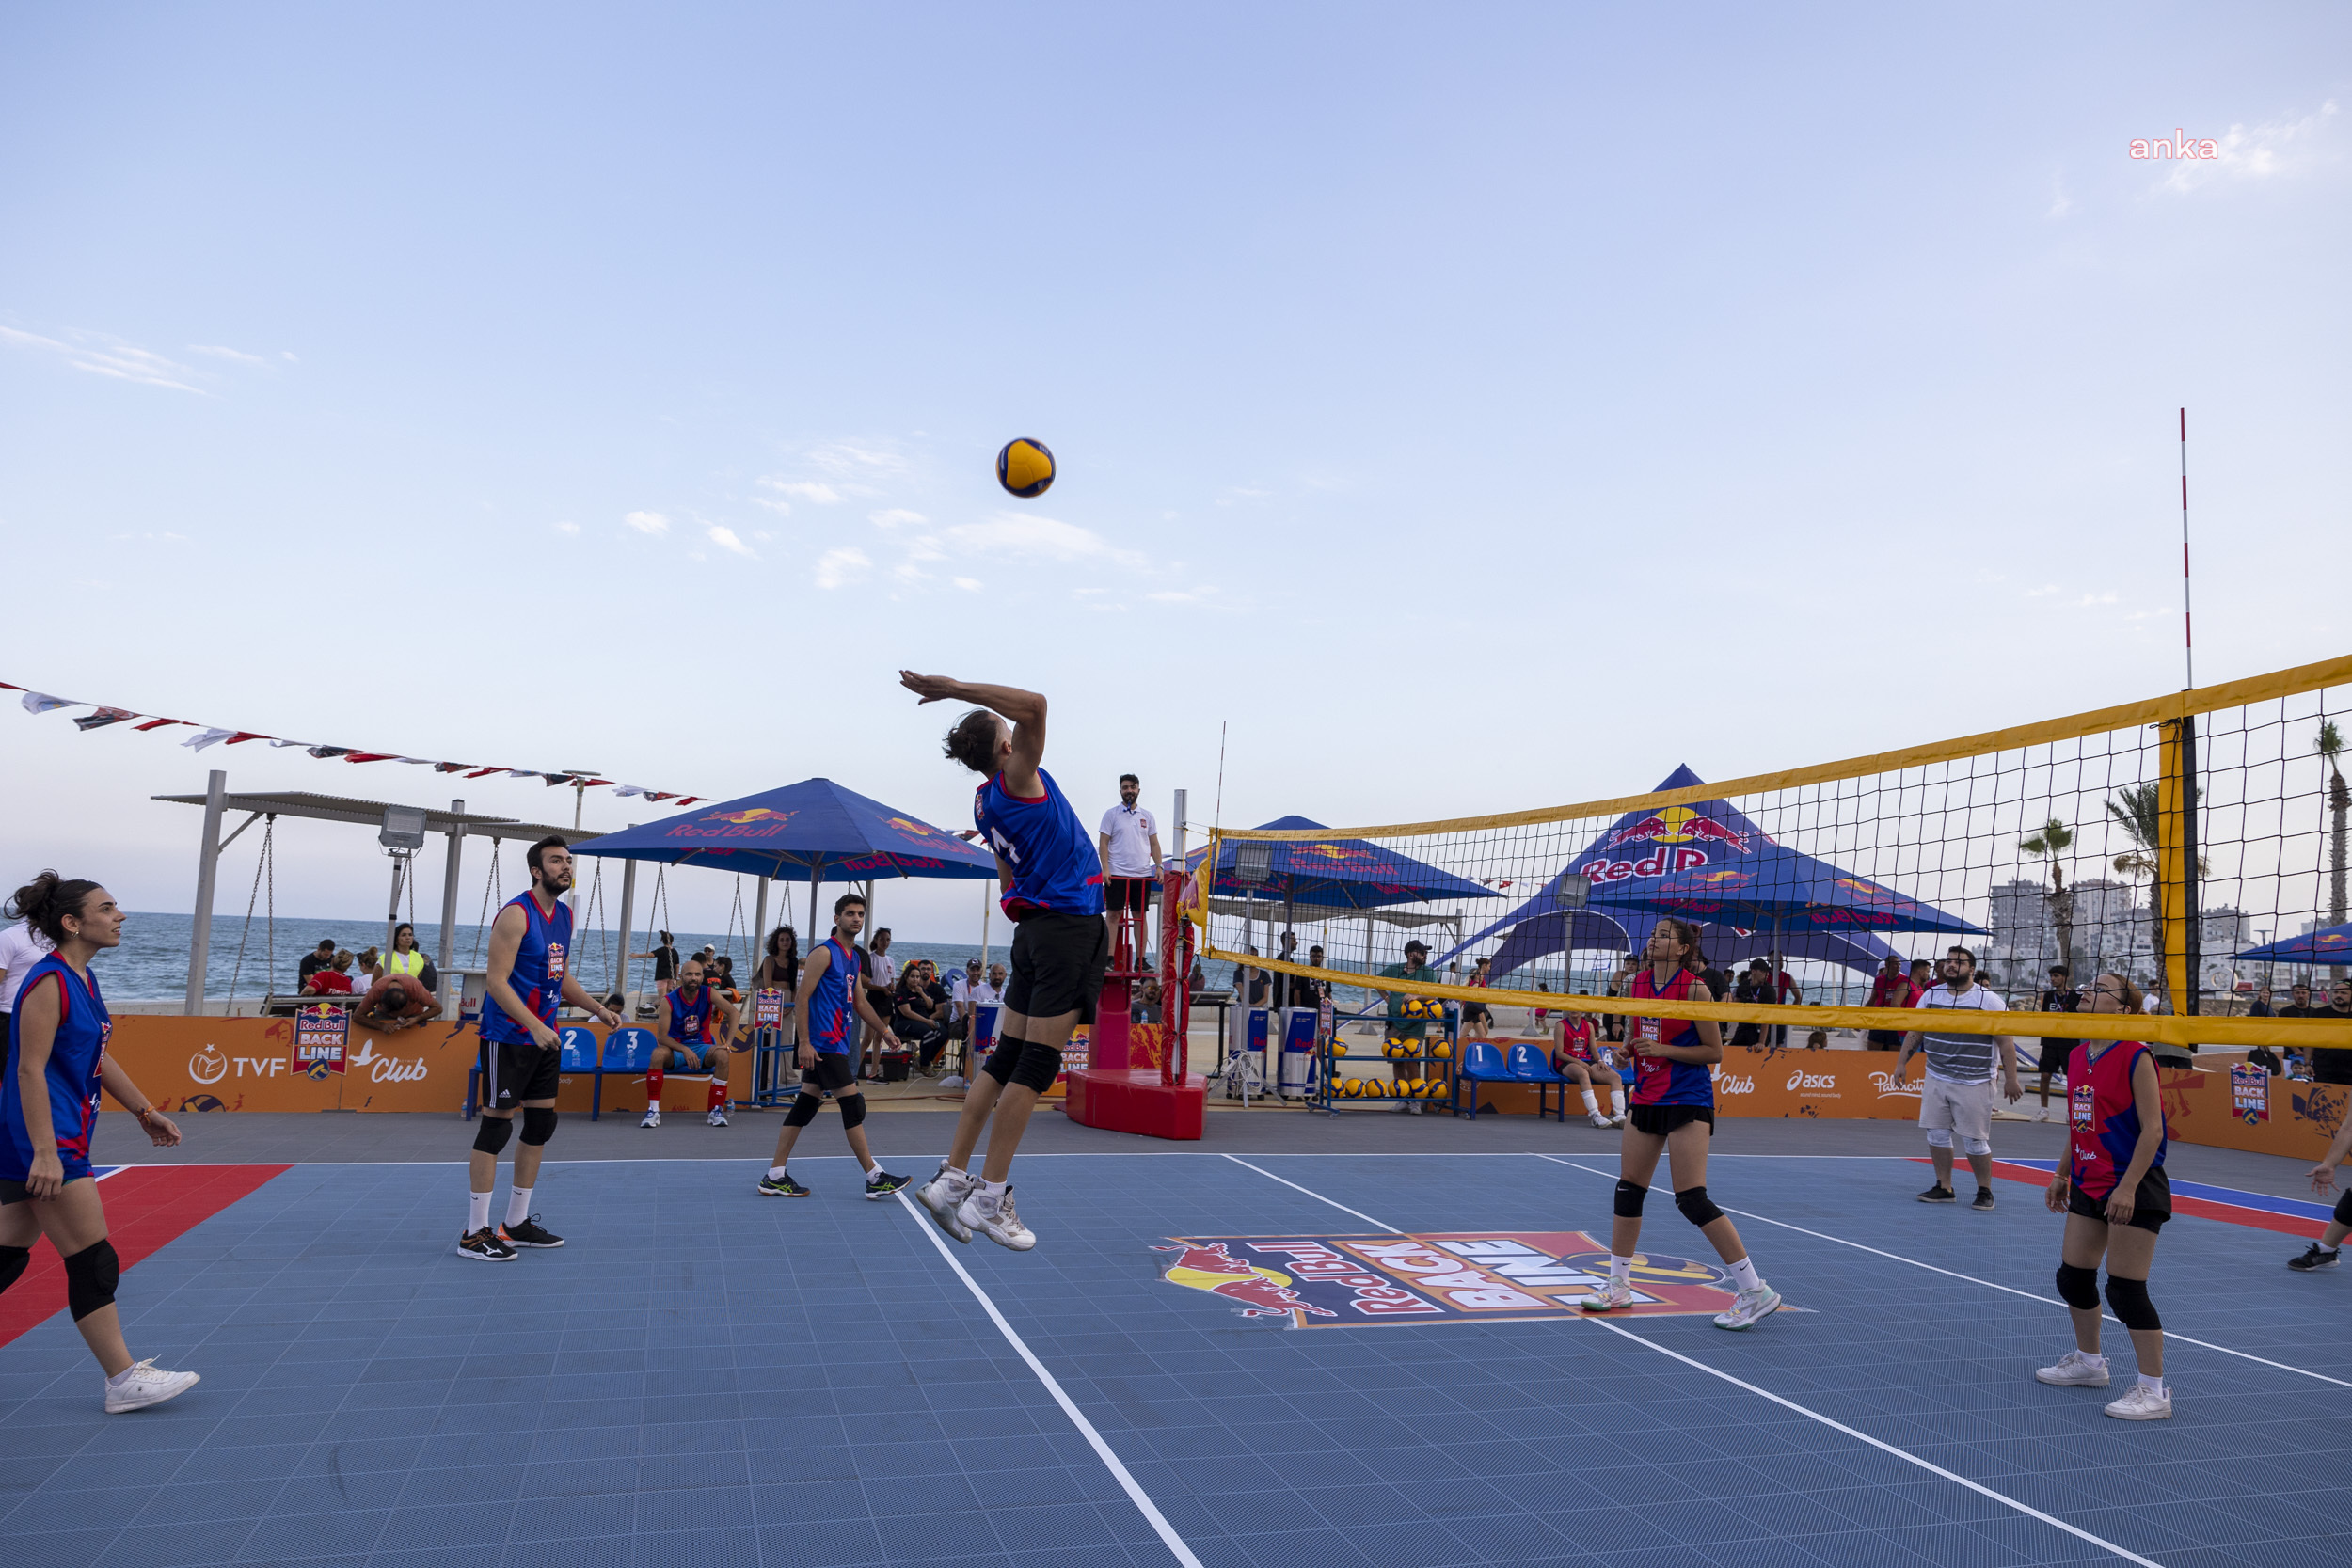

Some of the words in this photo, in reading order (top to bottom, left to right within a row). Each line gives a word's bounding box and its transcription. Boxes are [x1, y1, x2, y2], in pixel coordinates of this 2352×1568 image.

[664, 824, 731, 837] Red
[722, 824, 788, 837] Bull
[1288, 858, 1345, 871] Red
[1344, 861, 1399, 875] Bull
[1580, 846, 1670, 886] Red
[757, 1013, 779, 1022] LINE
[300, 1020, 323, 1030] Red
[324, 1020, 346, 1031] Bull
[300, 1033, 342, 1045] BACK
[564, 1030, 577, 1050] 2
[627, 1031, 639, 1050] 3
[1295, 1038, 1312, 1048] Red
[1642, 1033, 1658, 1041] LINE
[299, 1046, 342, 1060] LINE
[1060, 1053, 1088, 1062] BACK
[1476, 1045, 1483, 1062] 1
[1518, 1046, 1528, 1063] 2
[232, 1057, 287, 1078] TVF
[371, 1057, 428, 1083] Club
[1720, 1075, 1755, 1095] Club
[2233, 1074, 2249, 1085] Red
[2249, 1076, 2266, 1086] Bull
[2234, 1086, 2265, 1099] BACK
[2234, 1097, 2265, 1110] LINE
[2074, 1112, 2092, 1121] LINE
[1244, 1241, 1370, 1275] Bull
[1343, 1241, 1554, 1309] BACK
[1298, 1274, 1446, 1315] Red
